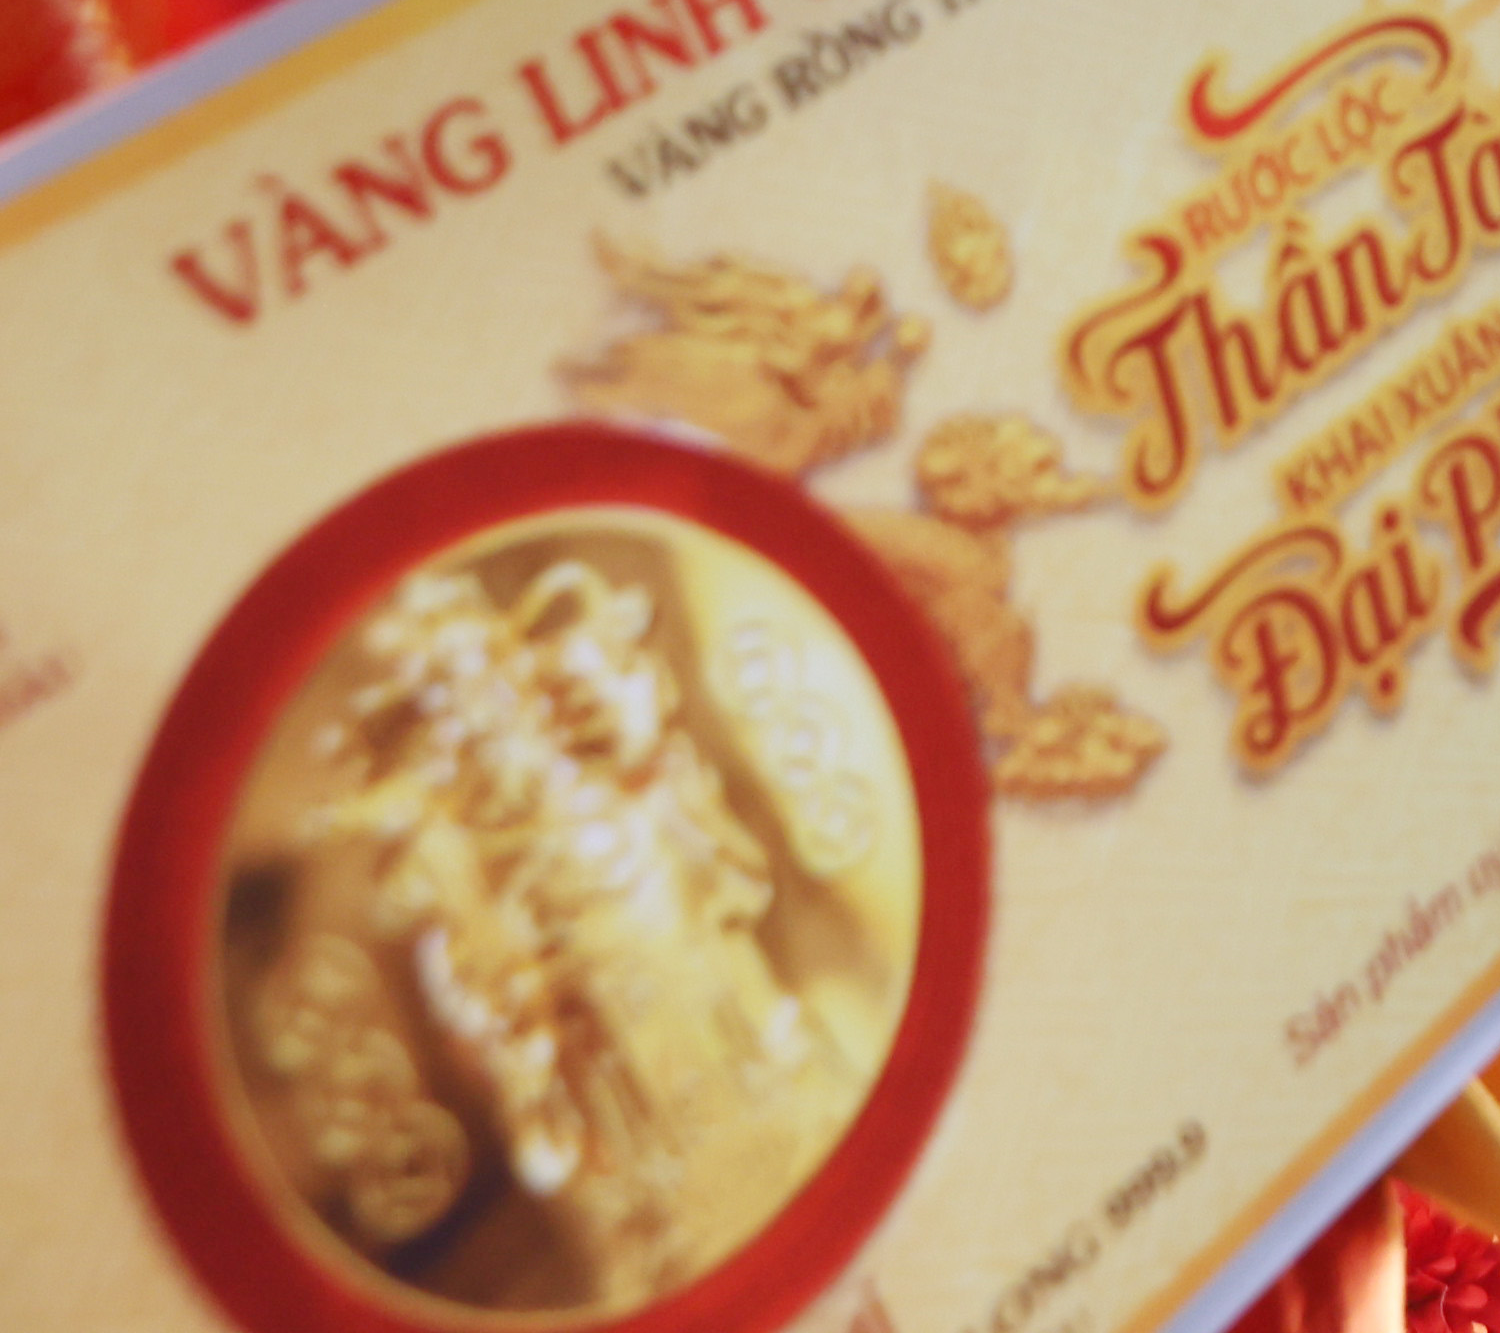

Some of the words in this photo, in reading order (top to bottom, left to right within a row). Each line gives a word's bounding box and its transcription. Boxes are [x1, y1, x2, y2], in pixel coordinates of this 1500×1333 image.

[170, 95, 513, 326] VÀNG
[607, 83, 771, 204] VÀNG
[1180, 127, 1312, 254] RƯỚC
[1318, 73, 1409, 175] LỘC
[1068, 221, 1408, 498] Thần
[1282, 407, 1396, 511] KHAI
[1145, 511, 1440, 758] Đại
